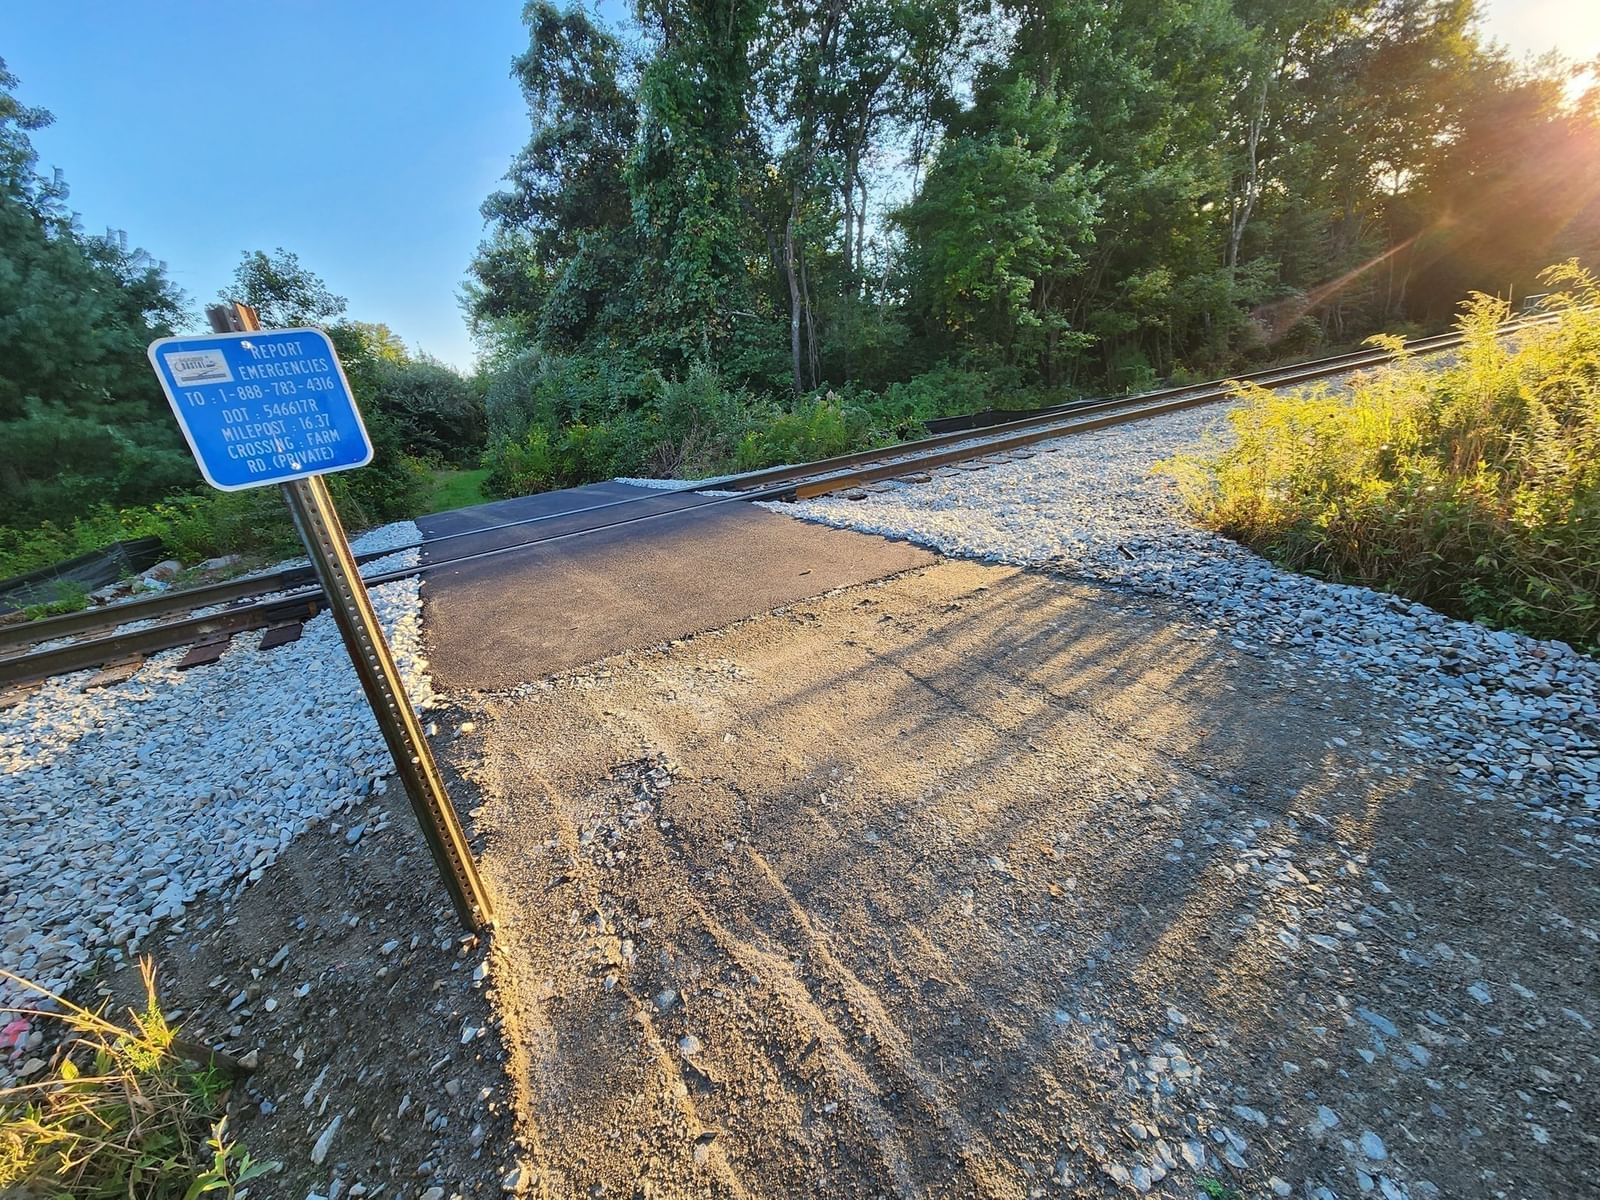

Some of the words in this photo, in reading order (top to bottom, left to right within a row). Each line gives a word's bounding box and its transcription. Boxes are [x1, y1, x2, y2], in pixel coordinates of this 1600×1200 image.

[252, 342, 303, 360] REPORT
[239, 358, 328, 380] EMERGENCIES
[263, 400, 318, 418] 546617R
[299, 413, 331, 430] 16.37
[307, 430, 341, 446] FARM
